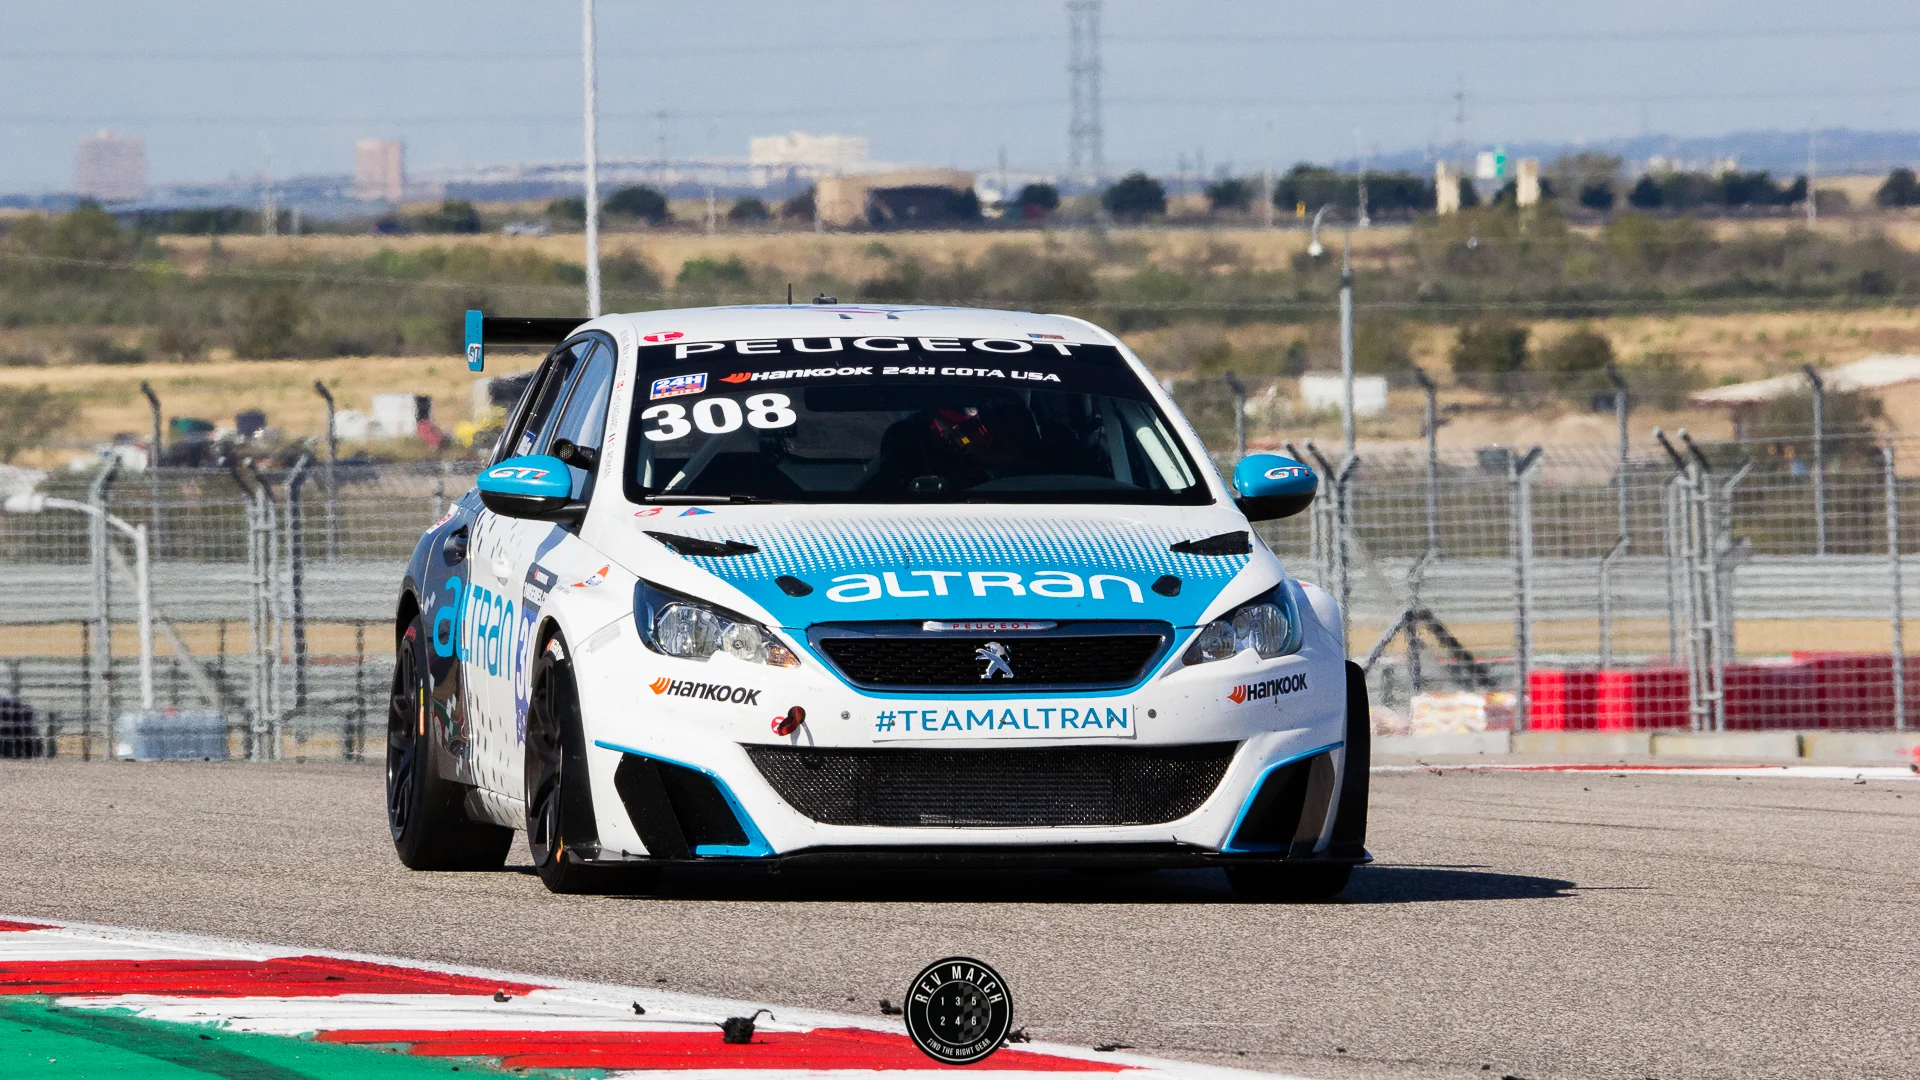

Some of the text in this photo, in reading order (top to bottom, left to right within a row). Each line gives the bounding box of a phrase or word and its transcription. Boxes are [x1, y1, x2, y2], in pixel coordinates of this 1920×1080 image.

[675, 337, 1081, 359] PEUGEOT
[656, 375, 702, 390] 24H
[882, 366, 936, 375] 24H
[940, 367, 1006, 378] COTA
[1010, 371, 1062, 383] USA
[641, 393, 797, 442] 308
[952, 621, 1032, 630] PEUGEOT
[875, 706, 1128, 733] #TEAMALTRAN
